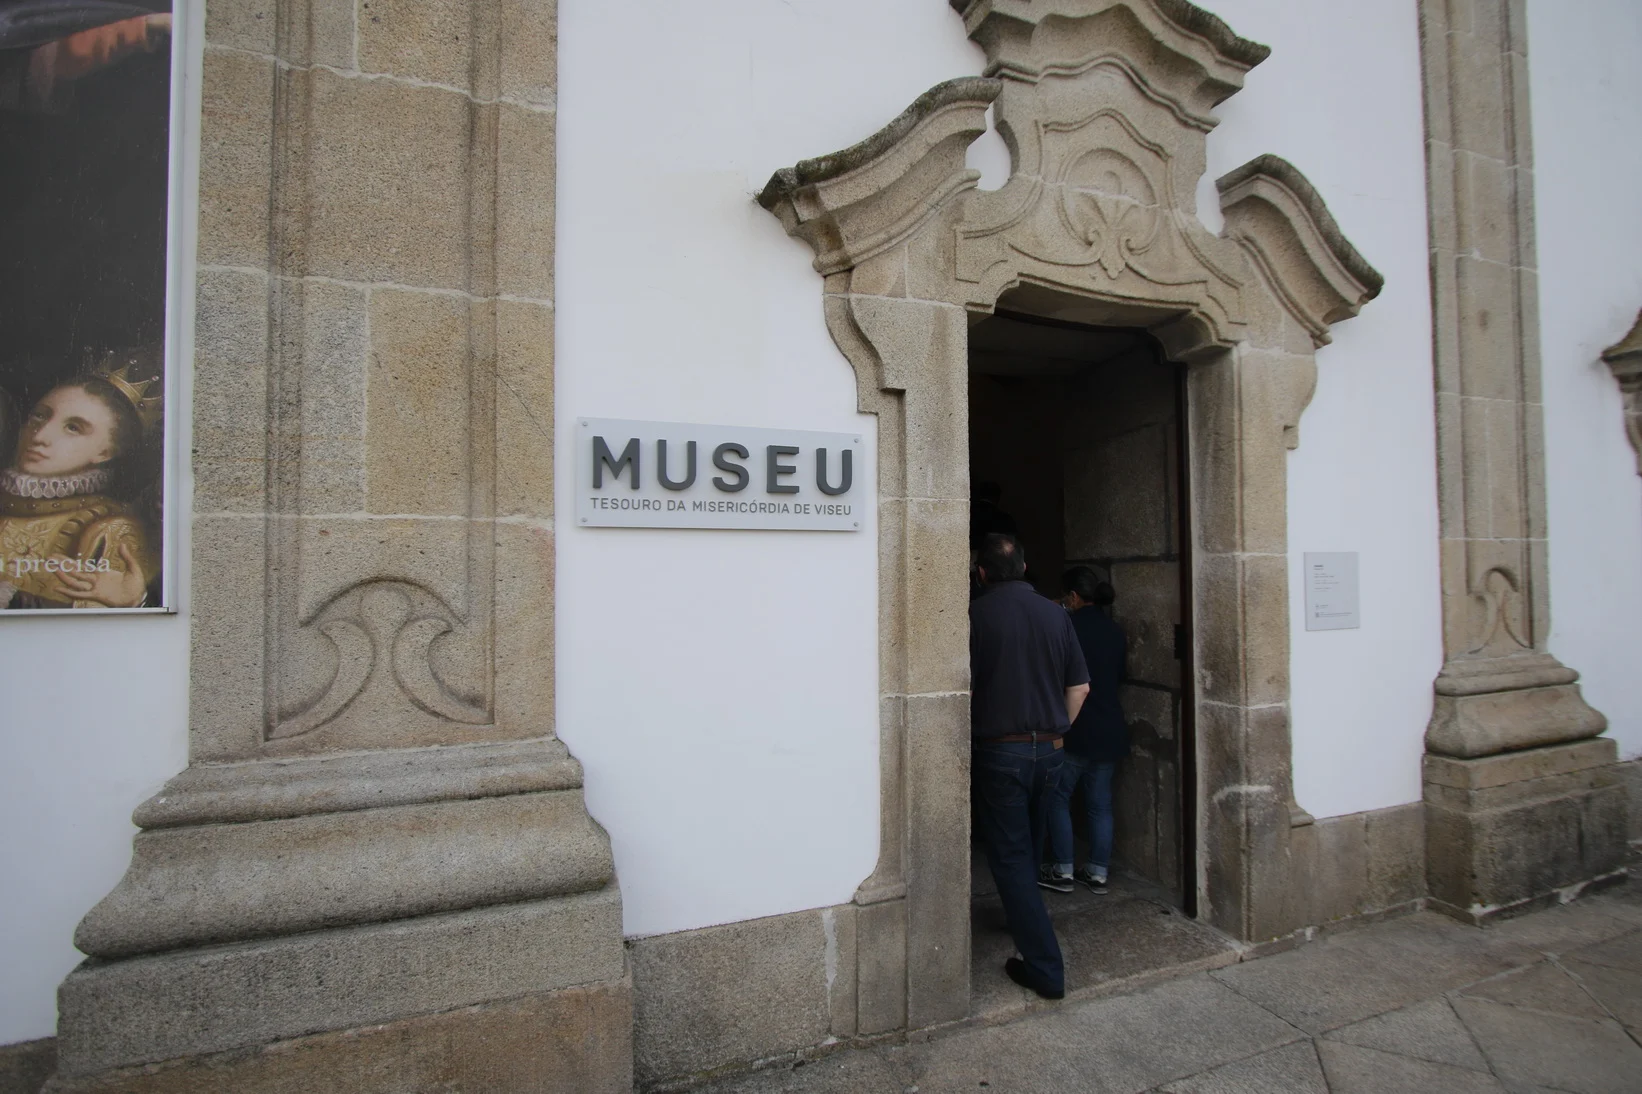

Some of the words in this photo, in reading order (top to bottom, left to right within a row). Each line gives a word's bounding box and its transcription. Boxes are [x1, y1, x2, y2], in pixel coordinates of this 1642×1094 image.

[593, 436, 853, 496] MUSEU
[590, 497, 661, 511] TESOURO
[667, 499, 686, 511] DA
[692, 500, 789, 514] MISERICÓRDIA
[794, 503, 810, 515] DE
[814, 504, 852, 516] VISEU
[15, 553, 110, 578] precisa
